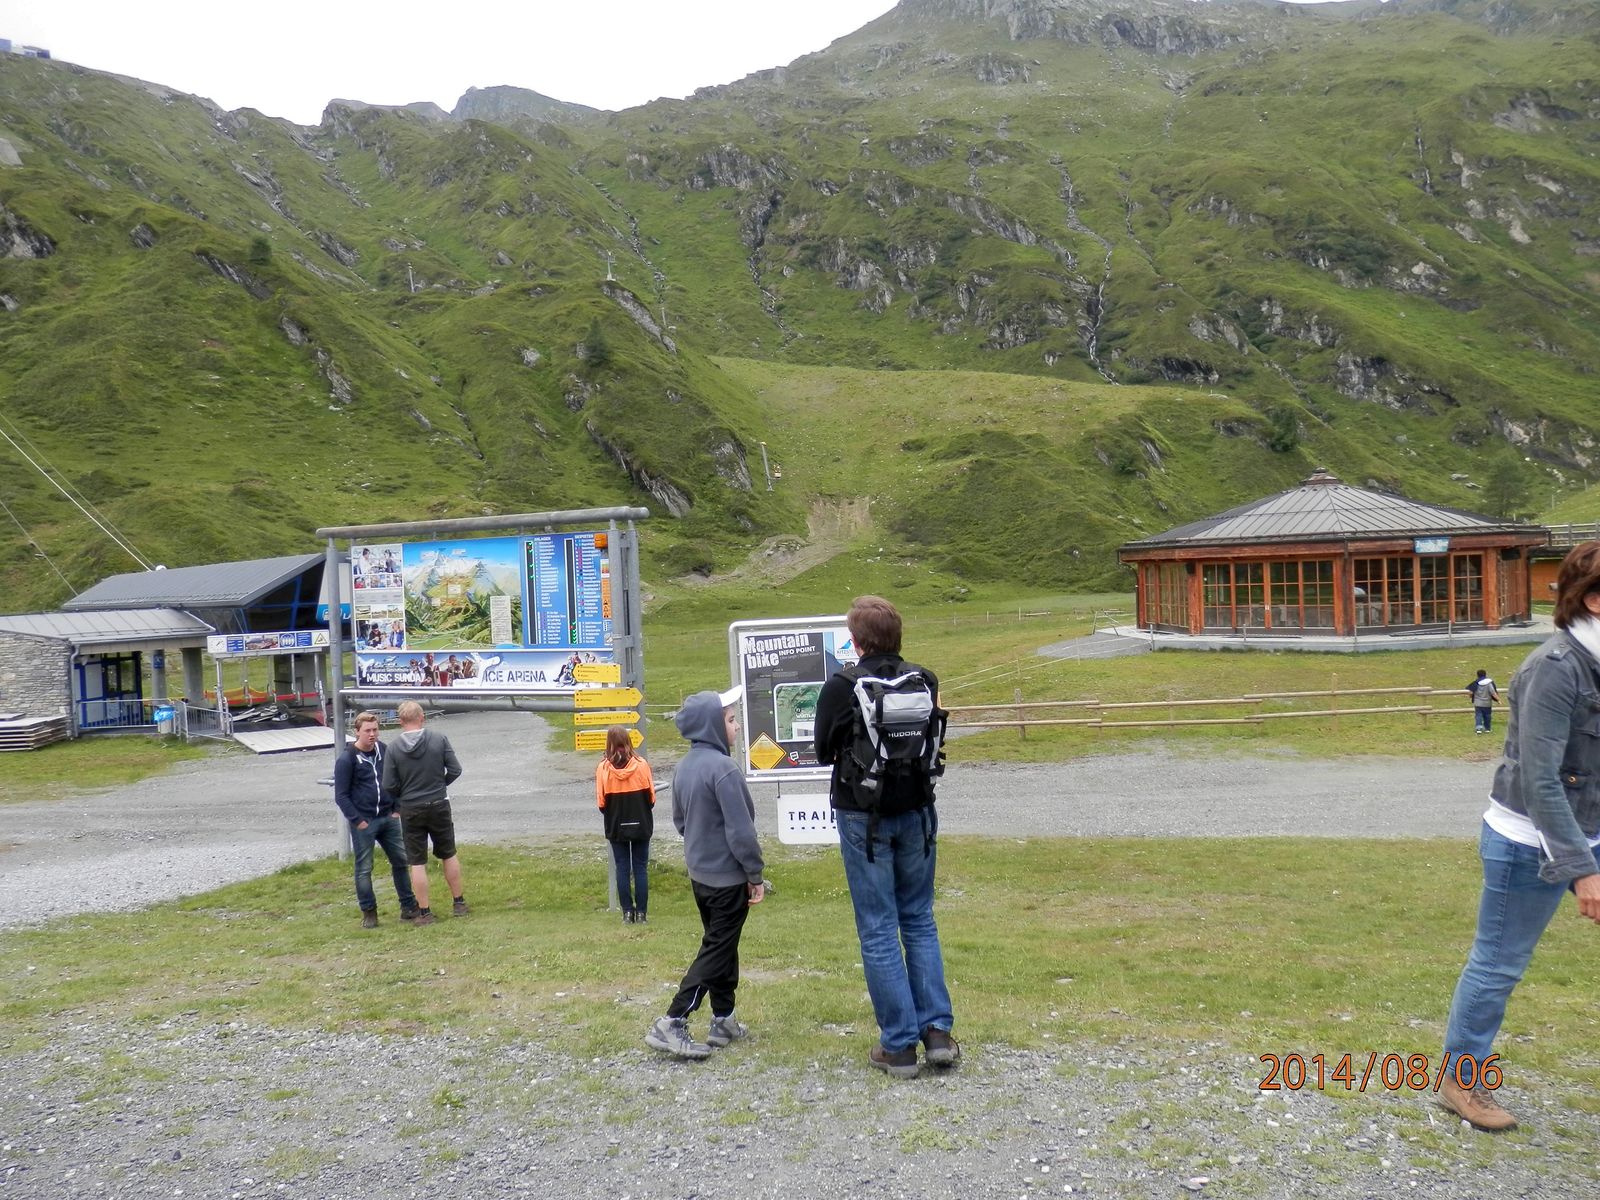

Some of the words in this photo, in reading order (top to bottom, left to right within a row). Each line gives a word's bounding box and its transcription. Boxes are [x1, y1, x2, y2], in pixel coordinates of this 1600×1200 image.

[740, 634, 810, 655] Mountain
[796, 646, 816, 654] POINT
[746, 652, 780, 669] bike
[366, 673, 393, 682] MUSIC
[394, 672, 425, 682] SUNDAY
[484, 671, 503, 682] ICE
[507, 671, 547, 682] ARENA
[888, 730, 922, 738] HUDORA
